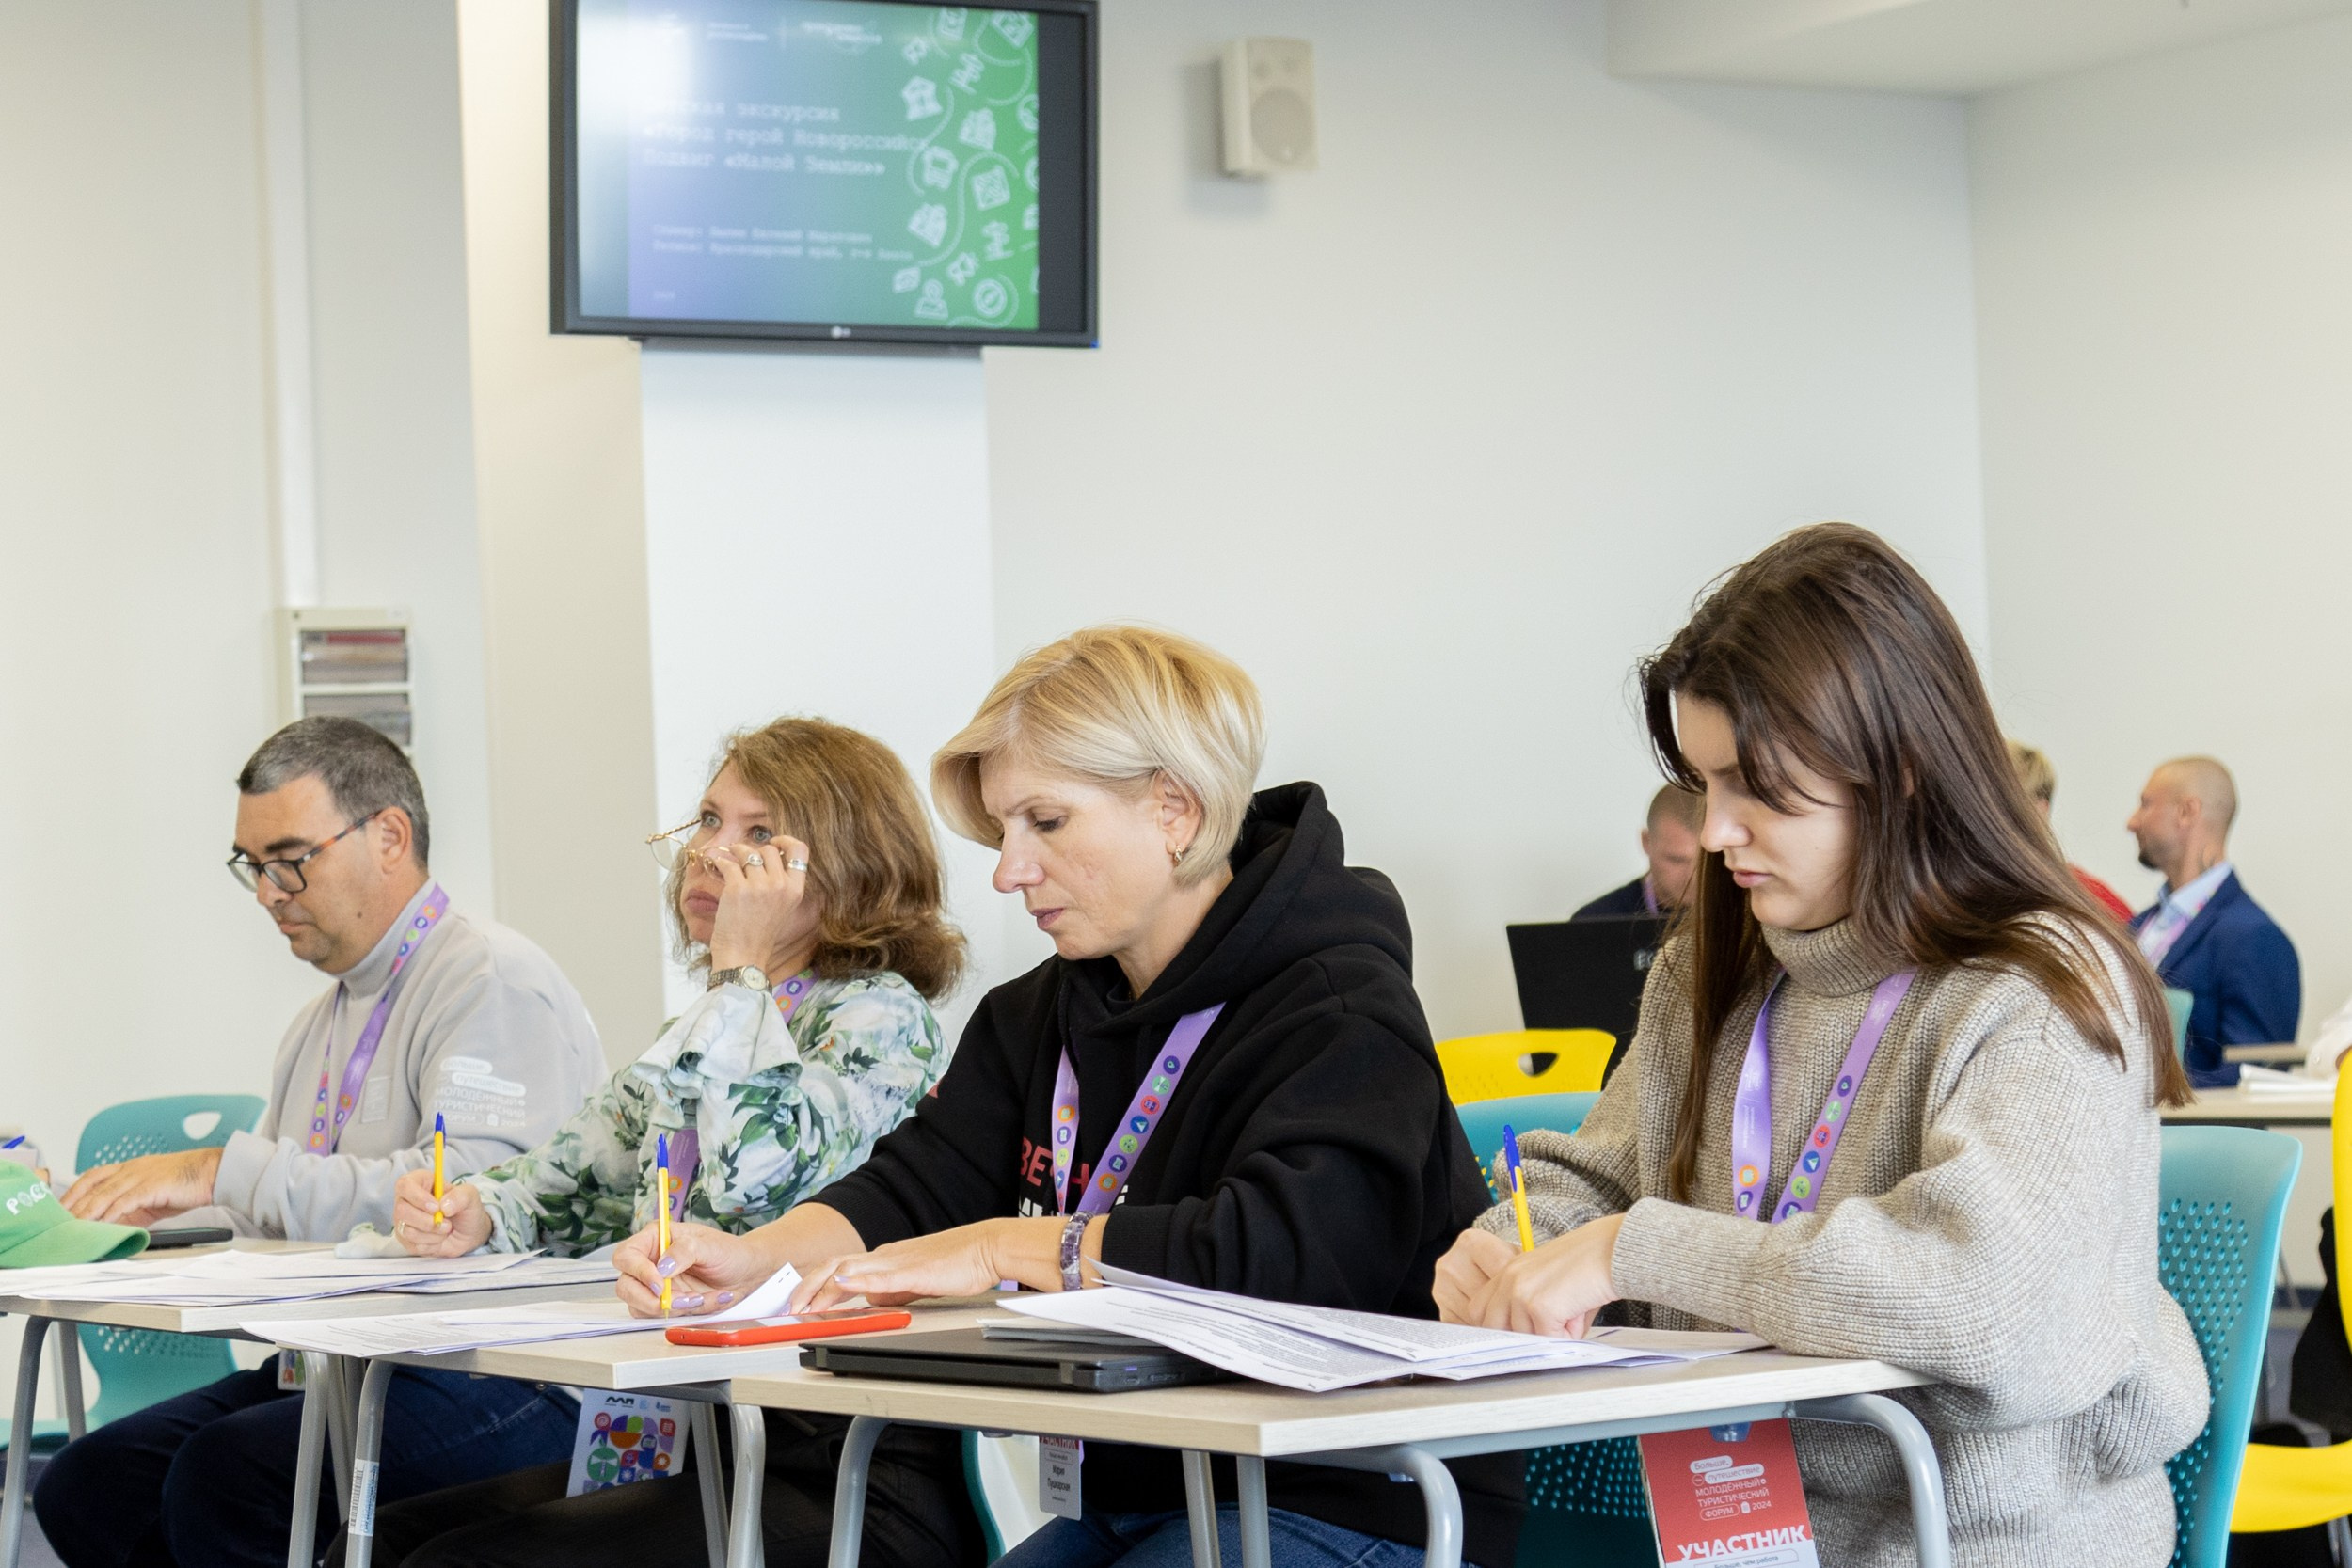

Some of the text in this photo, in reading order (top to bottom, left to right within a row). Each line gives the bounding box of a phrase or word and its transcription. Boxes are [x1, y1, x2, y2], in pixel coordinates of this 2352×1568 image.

[1697, 1487, 1770, 1507] ТУРИСТИЧЕСКИЙ
[1705, 1500, 1772, 1518] ФОРУМ 2024
[1677, 1525, 1806, 1561] УЧАСТНИК
